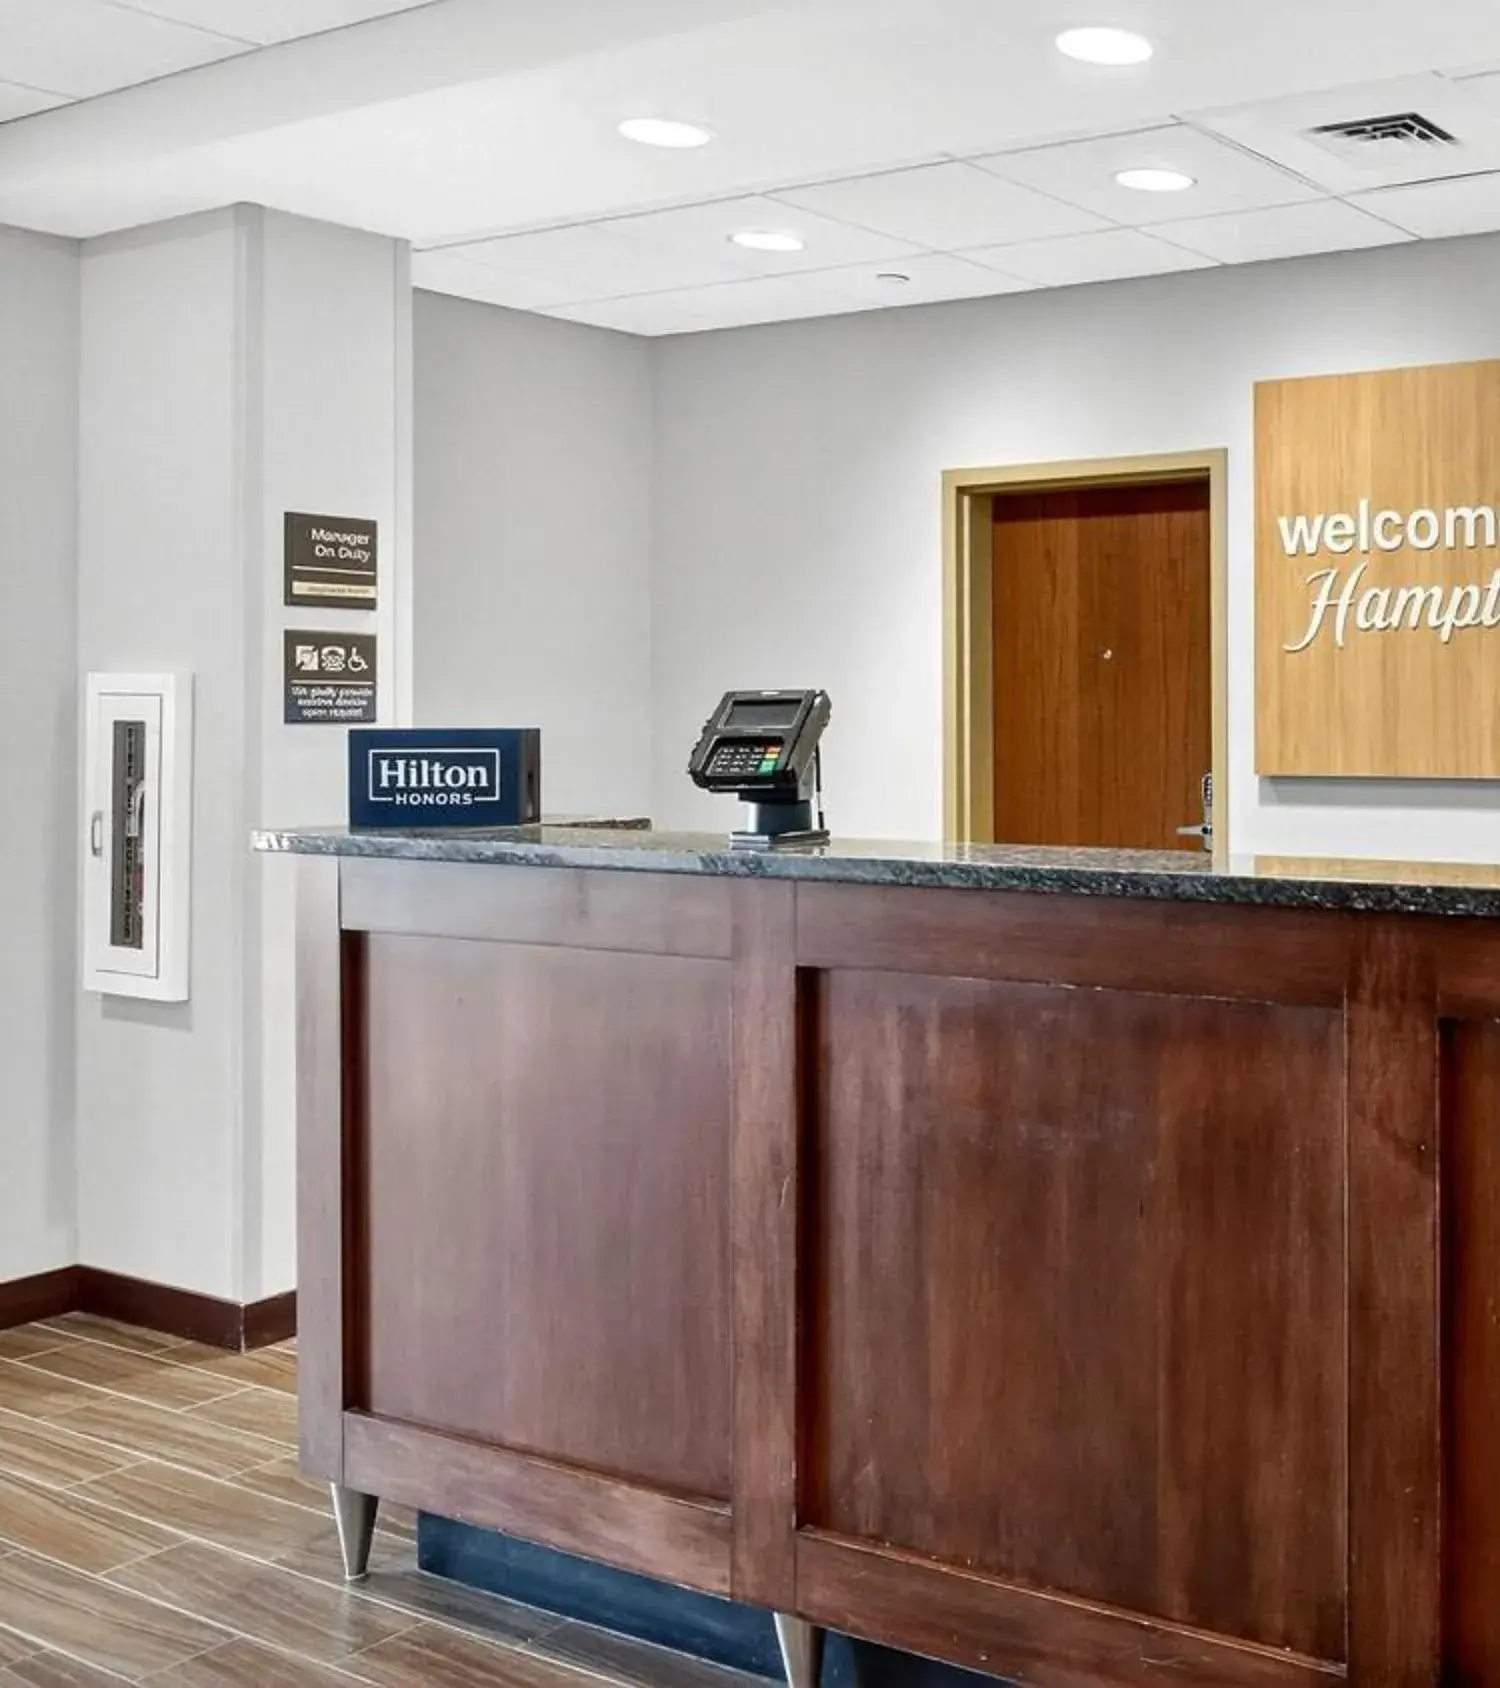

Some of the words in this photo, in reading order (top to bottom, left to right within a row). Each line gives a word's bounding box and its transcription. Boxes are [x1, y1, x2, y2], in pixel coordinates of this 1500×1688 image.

[311, 527, 370, 547] Manager
[315, 543, 335, 558] On
[338, 546, 371, 563] Duty
[378, 759, 489, 788] Hilton
[395, 792, 474, 806] HONORS
